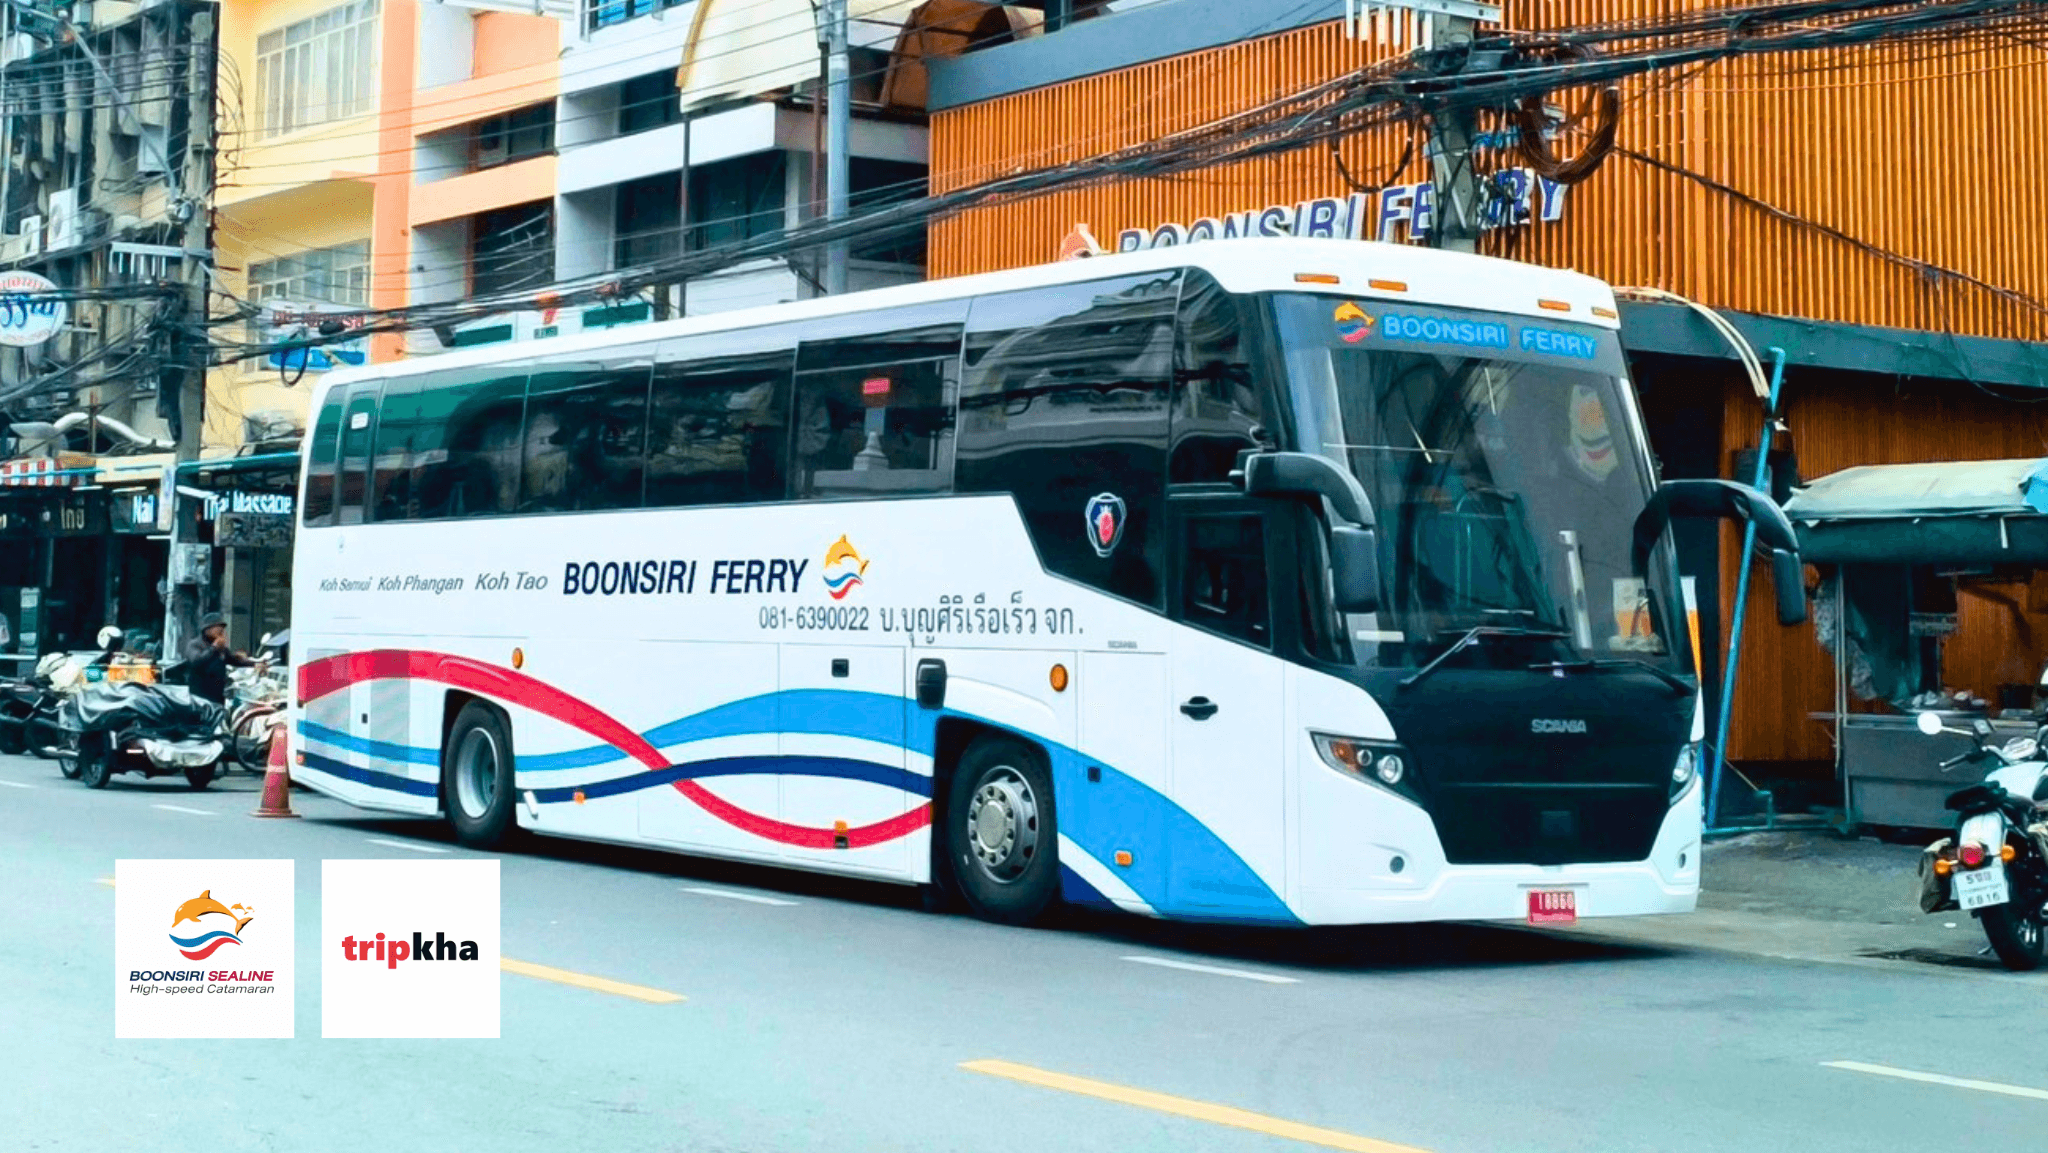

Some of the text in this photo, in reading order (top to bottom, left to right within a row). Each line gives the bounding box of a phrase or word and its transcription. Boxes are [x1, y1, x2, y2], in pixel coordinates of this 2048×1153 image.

[1376, 166, 1570, 242] FERY
[1383, 314, 1597, 357] BOONSIRI FERRY
[132, 494, 155, 523] Nail
[233, 489, 292, 514] Massage
[320, 576, 372, 591] Koh Samui
[377, 575, 464, 594] Koh Phangan
[475, 571, 549, 591] Koh Tao
[562, 558, 809, 596] BOONSIRI FERRY
[759, 606, 869, 632] 081-6390022
[1045, 606, 1084, 635] จก.
[1531, 719, 1587, 734] SCANIA
